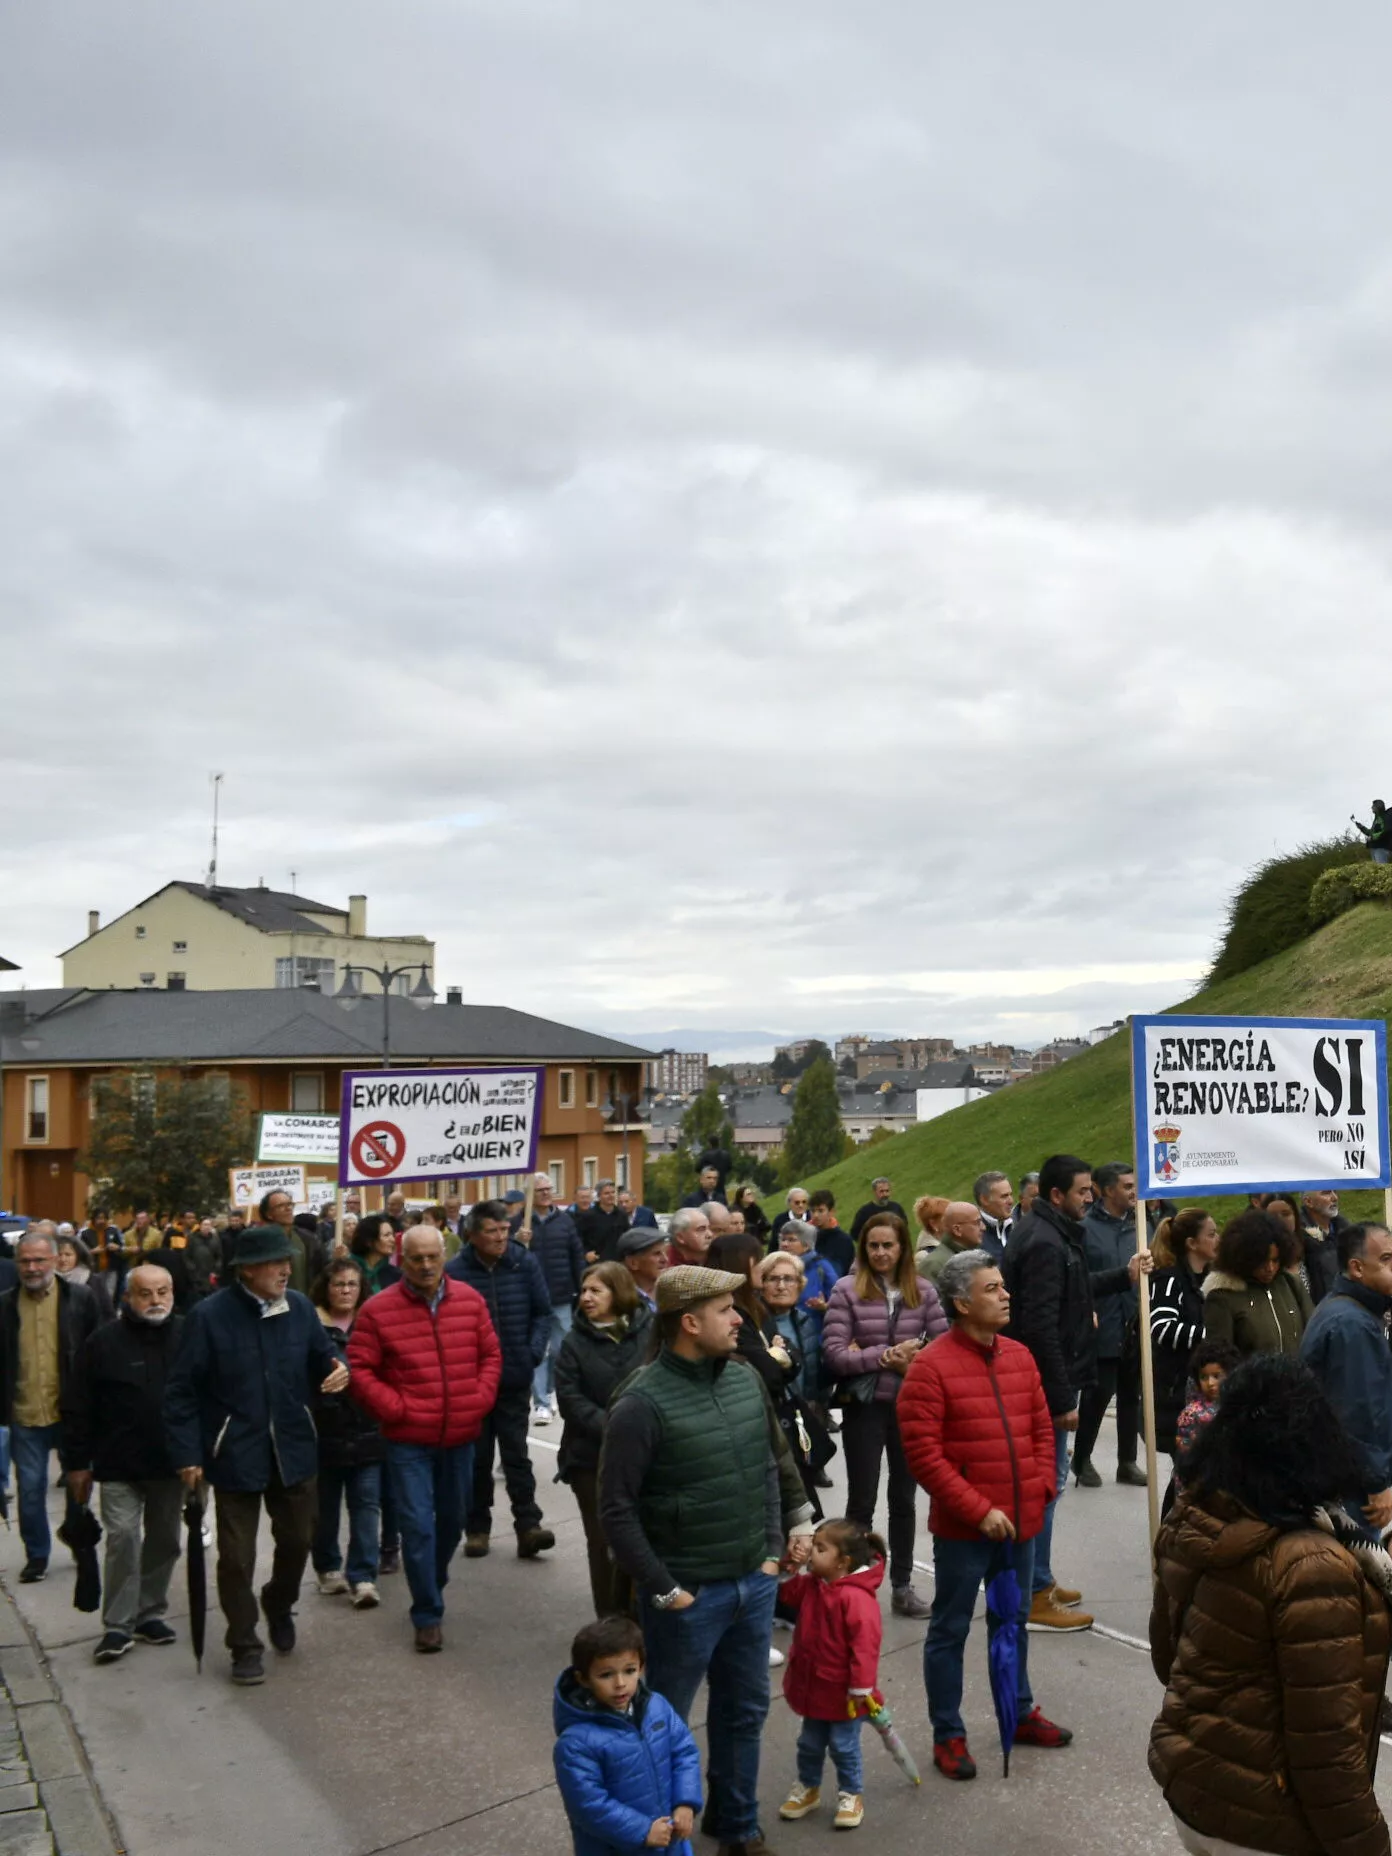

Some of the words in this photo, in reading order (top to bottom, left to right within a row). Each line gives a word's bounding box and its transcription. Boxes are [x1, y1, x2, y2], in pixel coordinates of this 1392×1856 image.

[1153, 1029, 1276, 1079] ¿ENERGÍA
[1313, 1036, 1366, 1117] SI
[353, 1078, 481, 1109] EXPROPIACIÓN
[1153, 1081, 1309, 1115] RENOVABLE?
[482, 1114, 527, 1134] BIEN
[1318, 1130, 1343, 1143] PERO
[1346, 1122, 1365, 1143] NO
[453, 1140, 525, 1162] QUIEN?
[1185, 1151, 1236, 1160] AYUNTAMIENTO
[1344, 1145, 1366, 1170] ASÍ
[1182, 1160, 1191, 1168] DE
